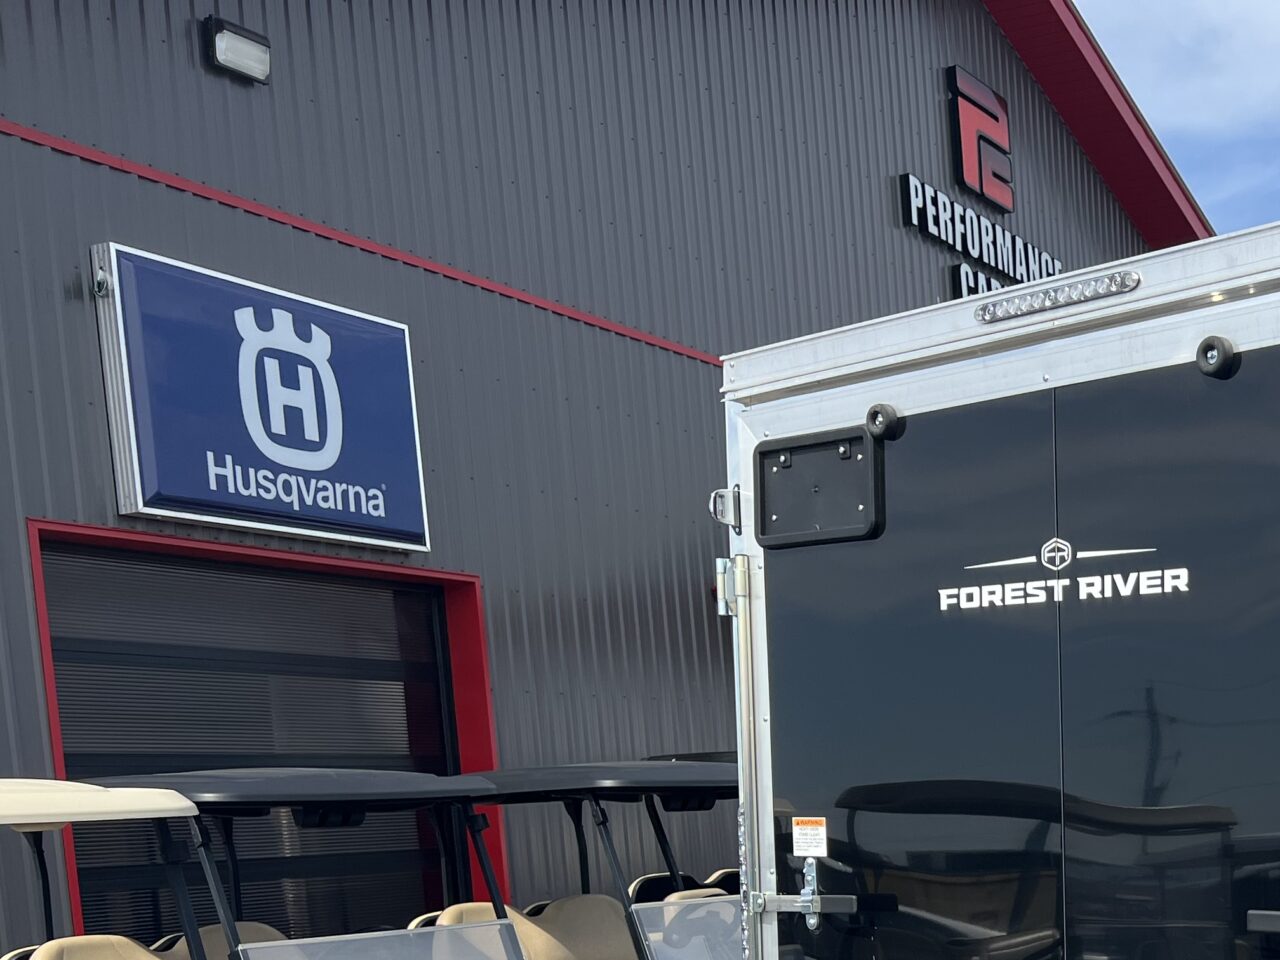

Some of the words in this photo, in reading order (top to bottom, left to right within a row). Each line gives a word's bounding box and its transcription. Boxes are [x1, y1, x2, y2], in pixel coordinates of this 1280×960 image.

[206, 450, 386, 518] Husqvarna
[938, 578, 1071, 611] FOREST
[1077, 567, 1190, 600] RIVER
